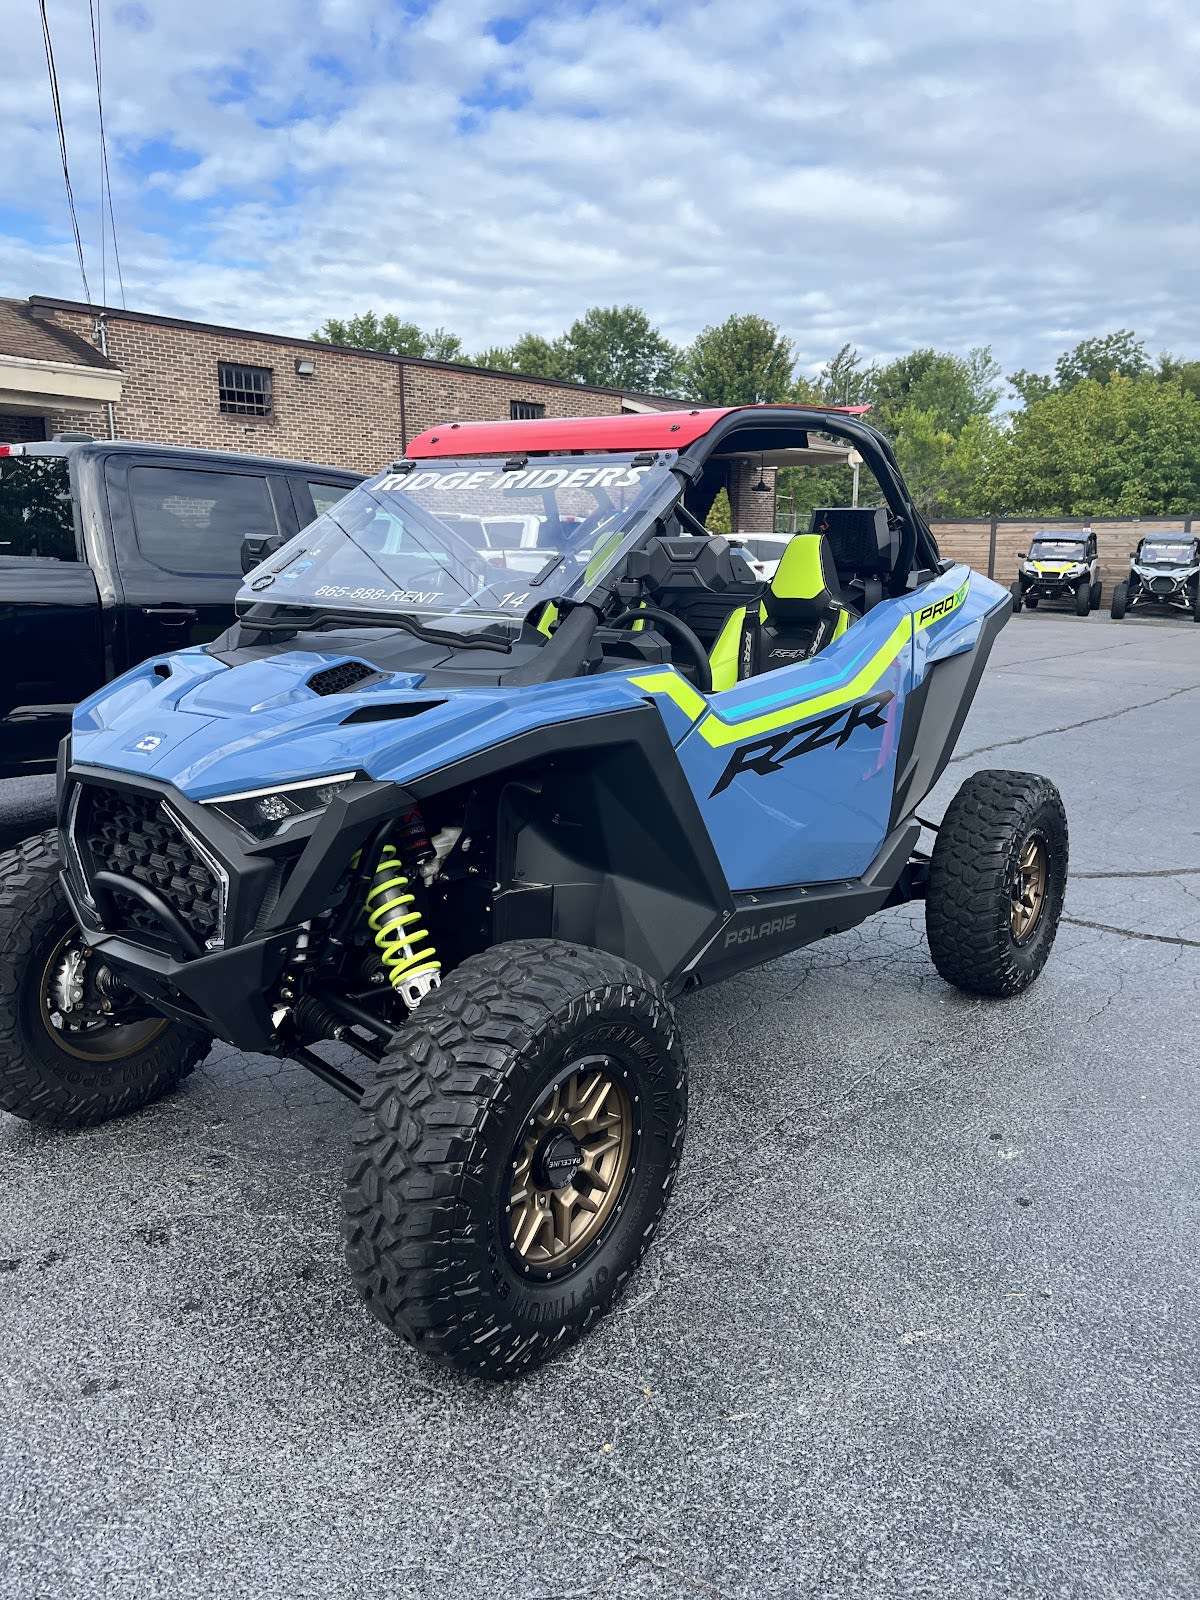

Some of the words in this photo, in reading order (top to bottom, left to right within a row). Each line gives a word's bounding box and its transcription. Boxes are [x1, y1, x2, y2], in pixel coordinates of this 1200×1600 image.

[370, 471, 493, 491] RIDGE
[490, 466, 652, 490] RIDERS
[314, 584, 445, 605] 865-888-RENT
[499, 591, 530, 608] 14
[919, 594, 955, 626] PRO
[707, 690, 895, 800] RZR
[724, 913, 798, 948] POLARIS
[549, 1157, 581, 1168] RACELINE
[511, 1266, 609, 1322] OPTIMUM
